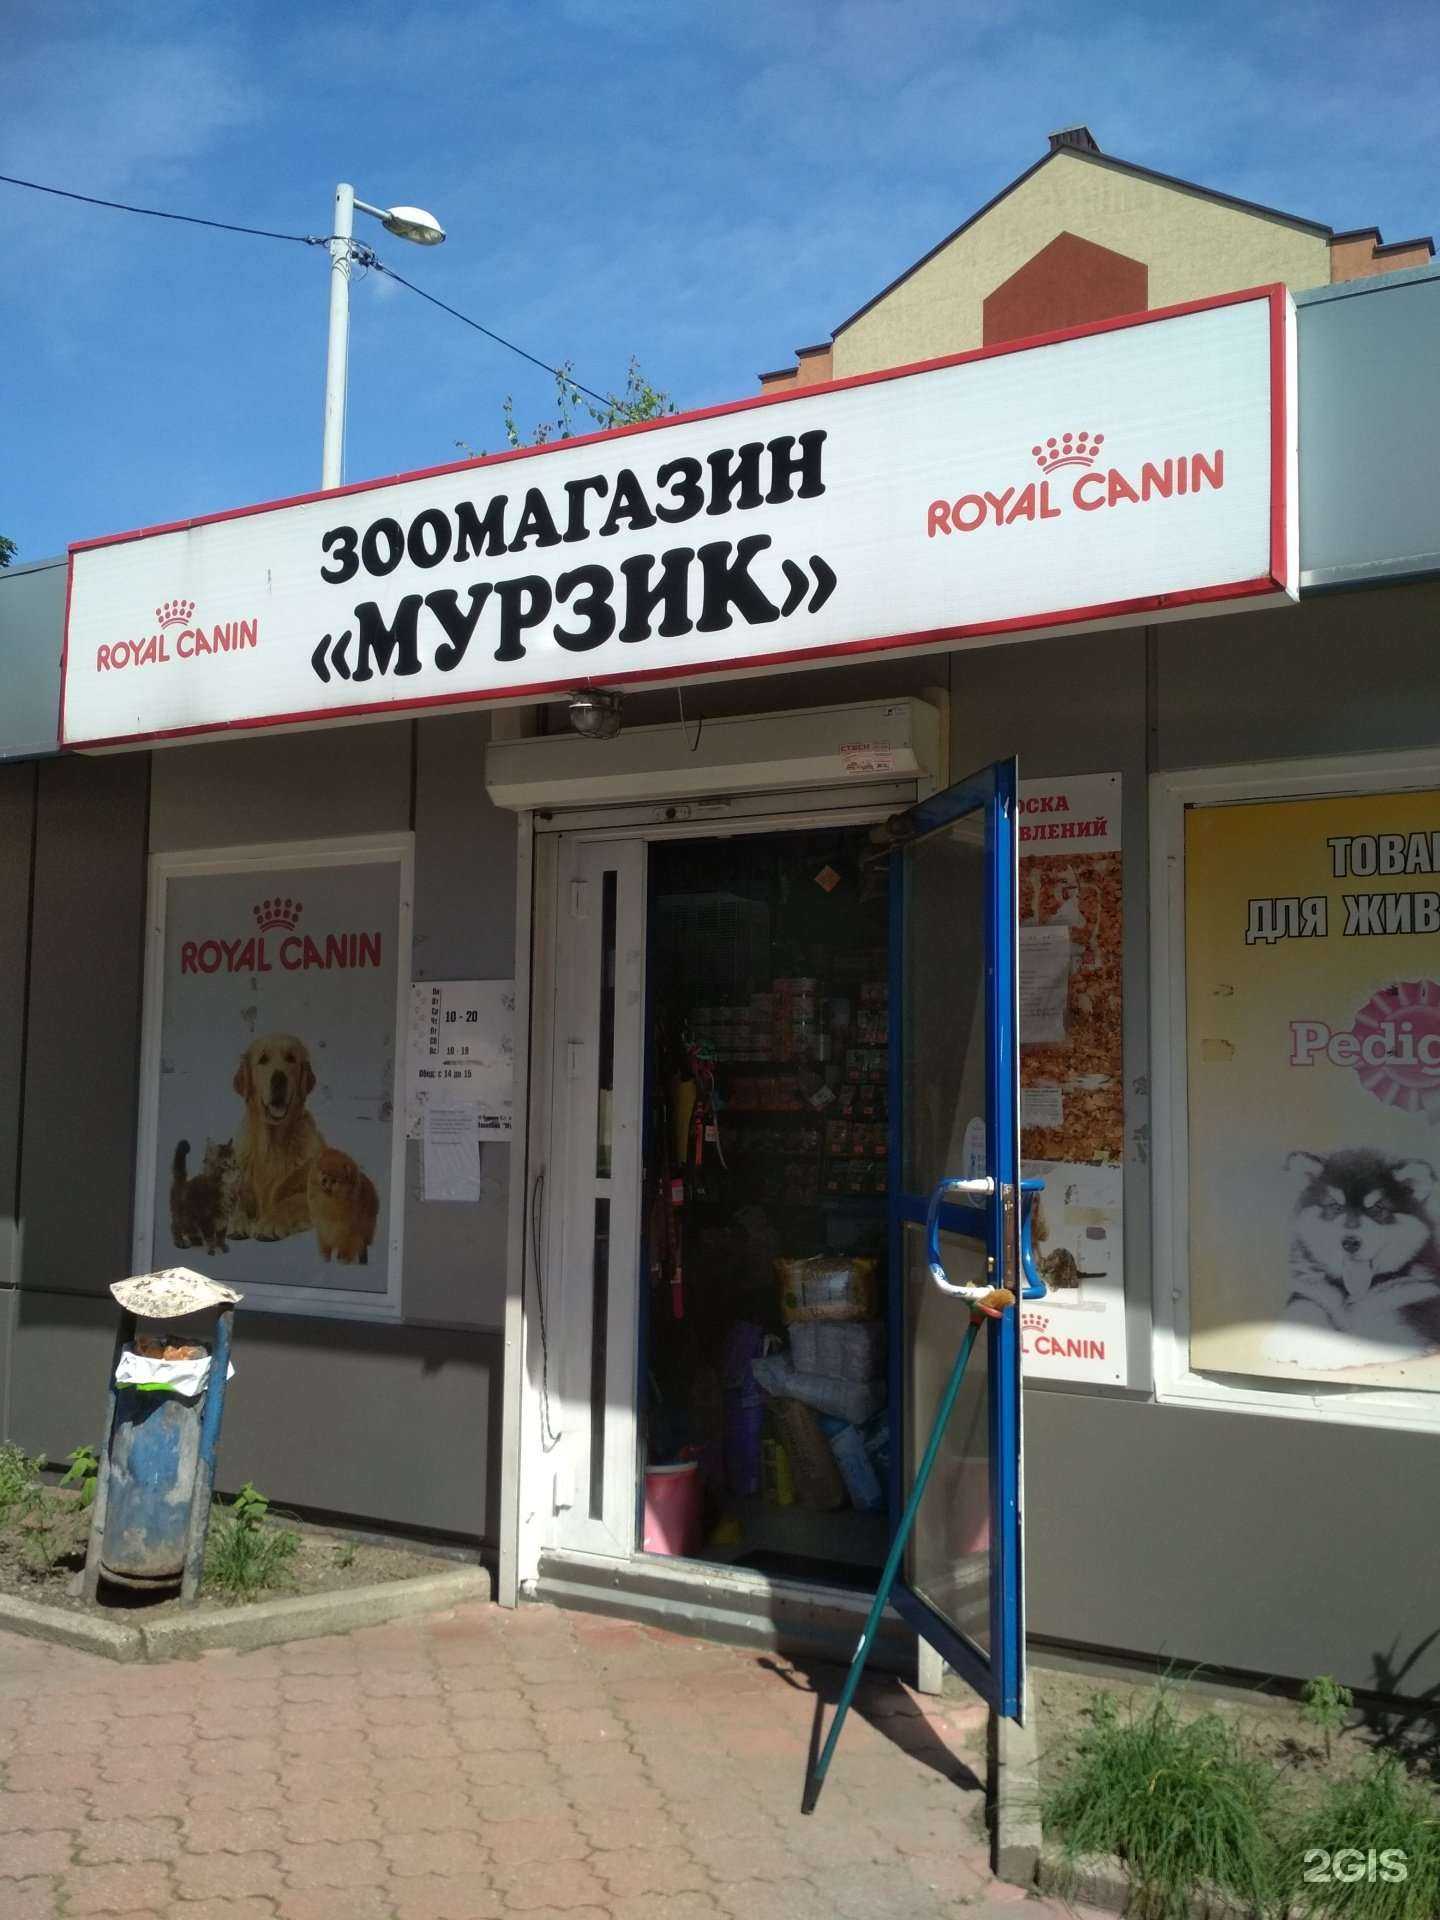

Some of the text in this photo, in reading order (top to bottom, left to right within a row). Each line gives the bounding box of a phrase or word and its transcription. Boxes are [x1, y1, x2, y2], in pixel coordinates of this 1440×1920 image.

[321, 429, 828, 584] ЗООМАГАЗИН
[928, 449, 1224, 538] ROYAL CANIN
[311, 534, 838, 683] «МУРЗИК»
[96, 618, 258, 672] ROYAL CANIN
[1245, 896, 1328, 945] ДЛЯ
[181, 932, 382, 974] ROYAL CANIN
[445, 1010, 456, 1023] 10
[465, 1010, 478, 1023] 20
[1034, 1335, 1106, 1361] CANIN
